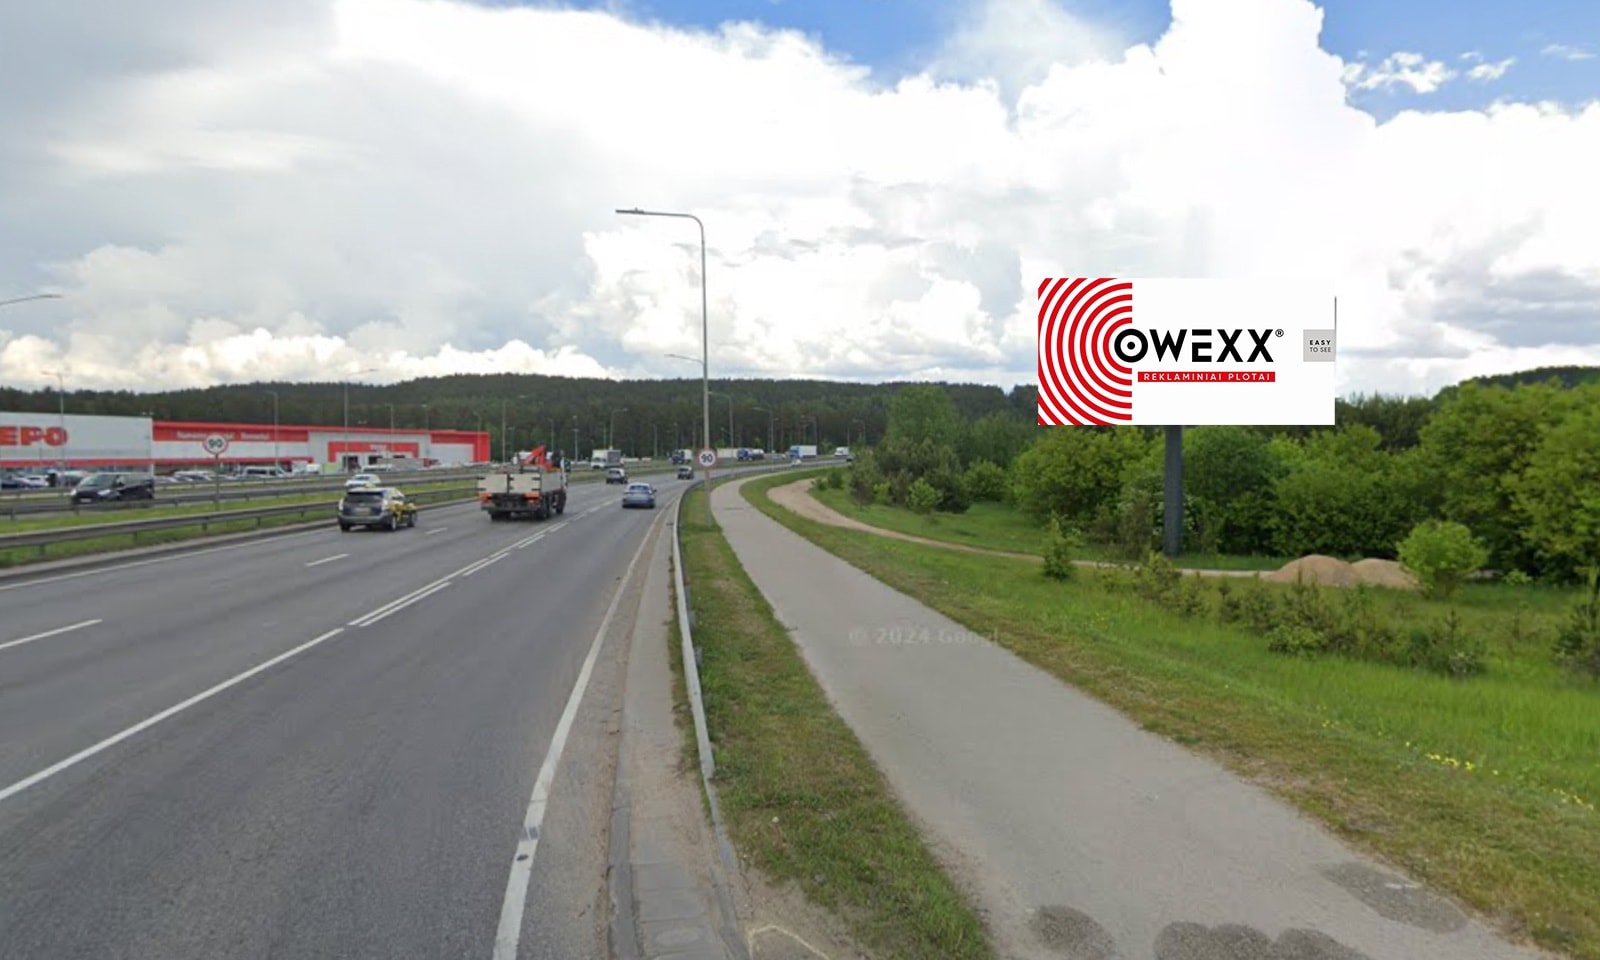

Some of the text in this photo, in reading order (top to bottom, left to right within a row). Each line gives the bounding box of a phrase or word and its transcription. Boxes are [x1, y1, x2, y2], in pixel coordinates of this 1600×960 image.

[1144, 373, 1271, 381] REKLAMINIAI PLOTAI
[208, 438, 224, 449] 90
[701, 453, 713, 463] 90
